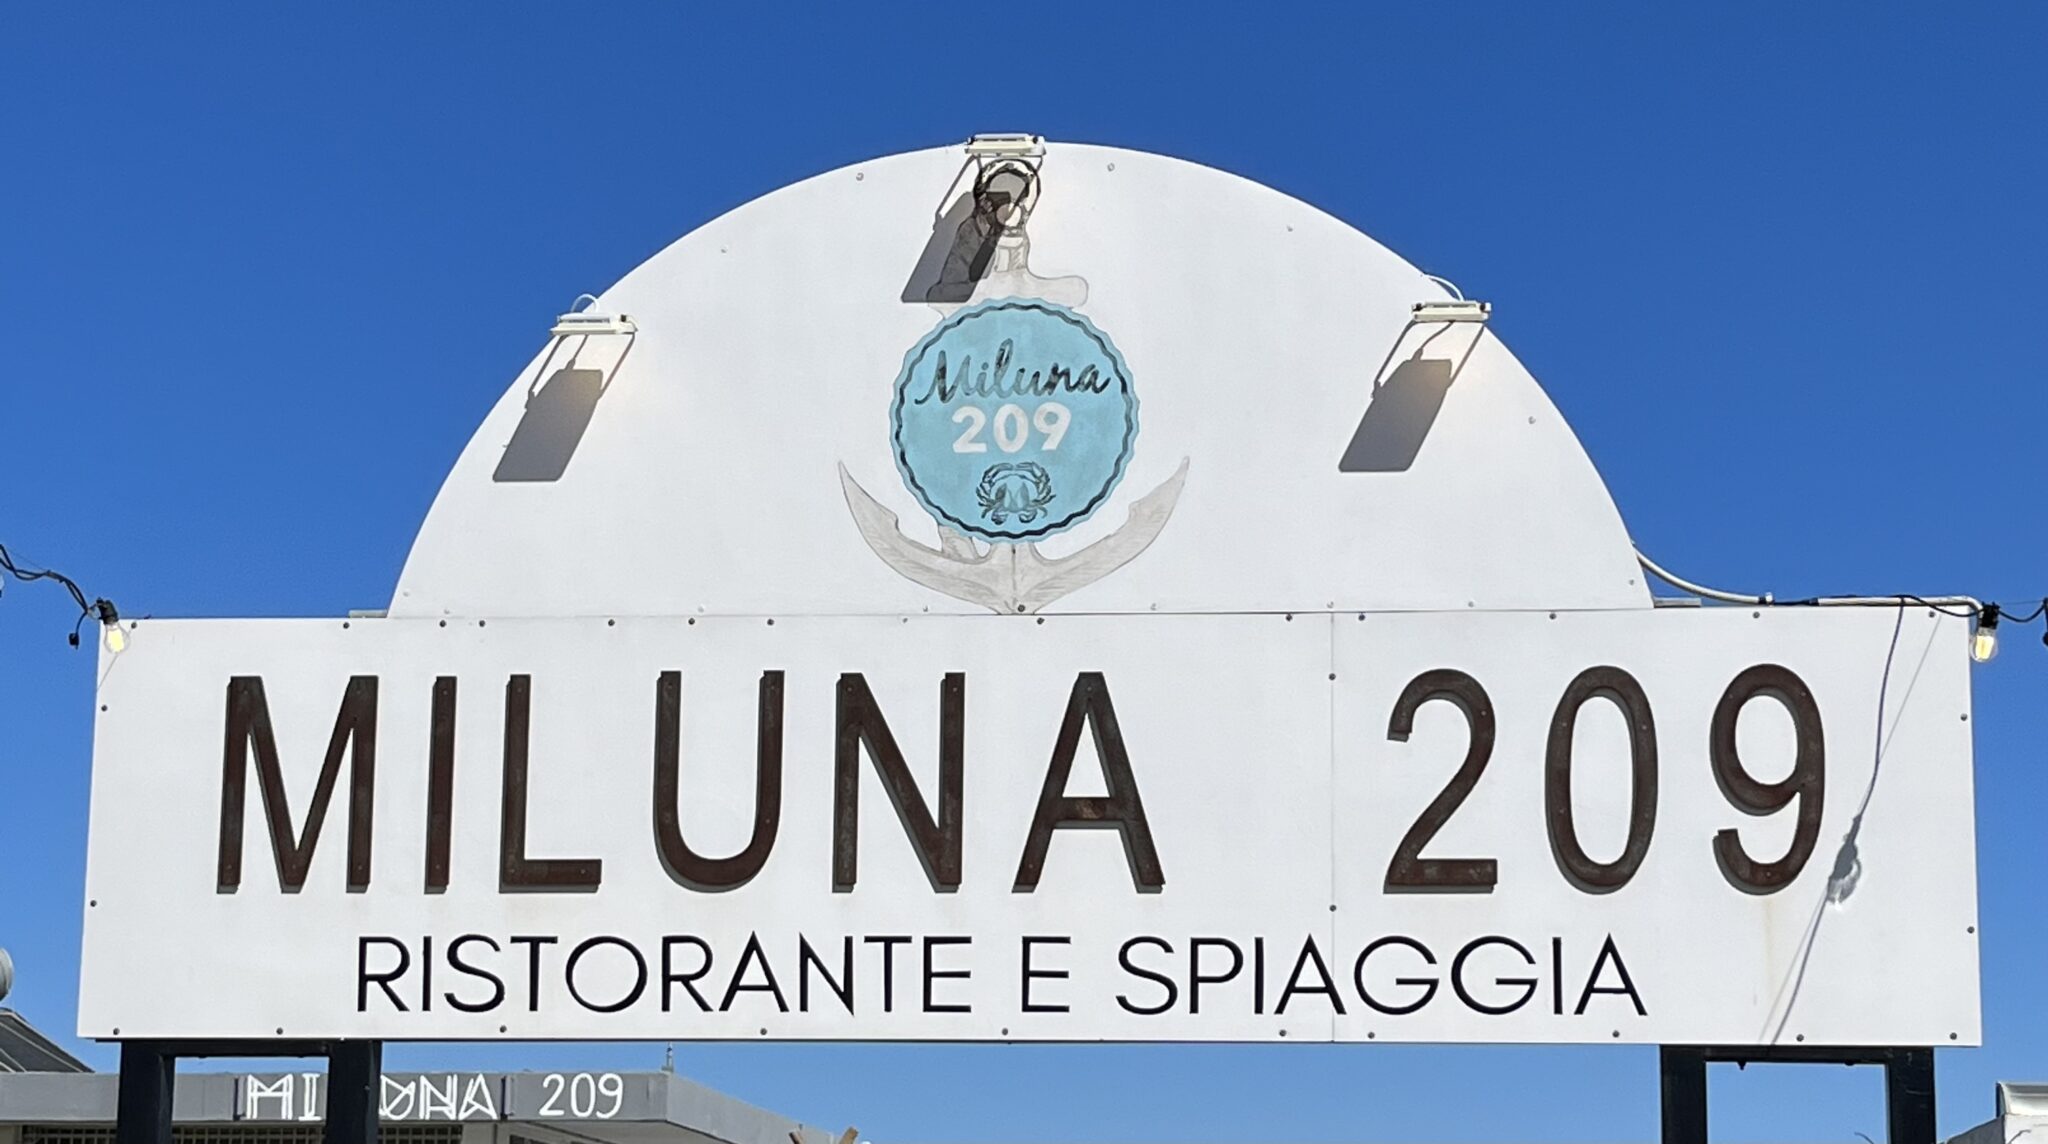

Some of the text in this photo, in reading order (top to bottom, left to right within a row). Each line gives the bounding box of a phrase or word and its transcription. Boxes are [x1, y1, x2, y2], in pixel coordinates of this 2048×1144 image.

[914, 338, 1111, 404] Miluna
[951, 402, 1072, 453] 209
[216, 663, 1826, 896] MILUNA 209
[357, 931, 1648, 1016] RISTORANTE E SPIAGGIA
[246, 1072, 624, 1121] MIUNA 209
